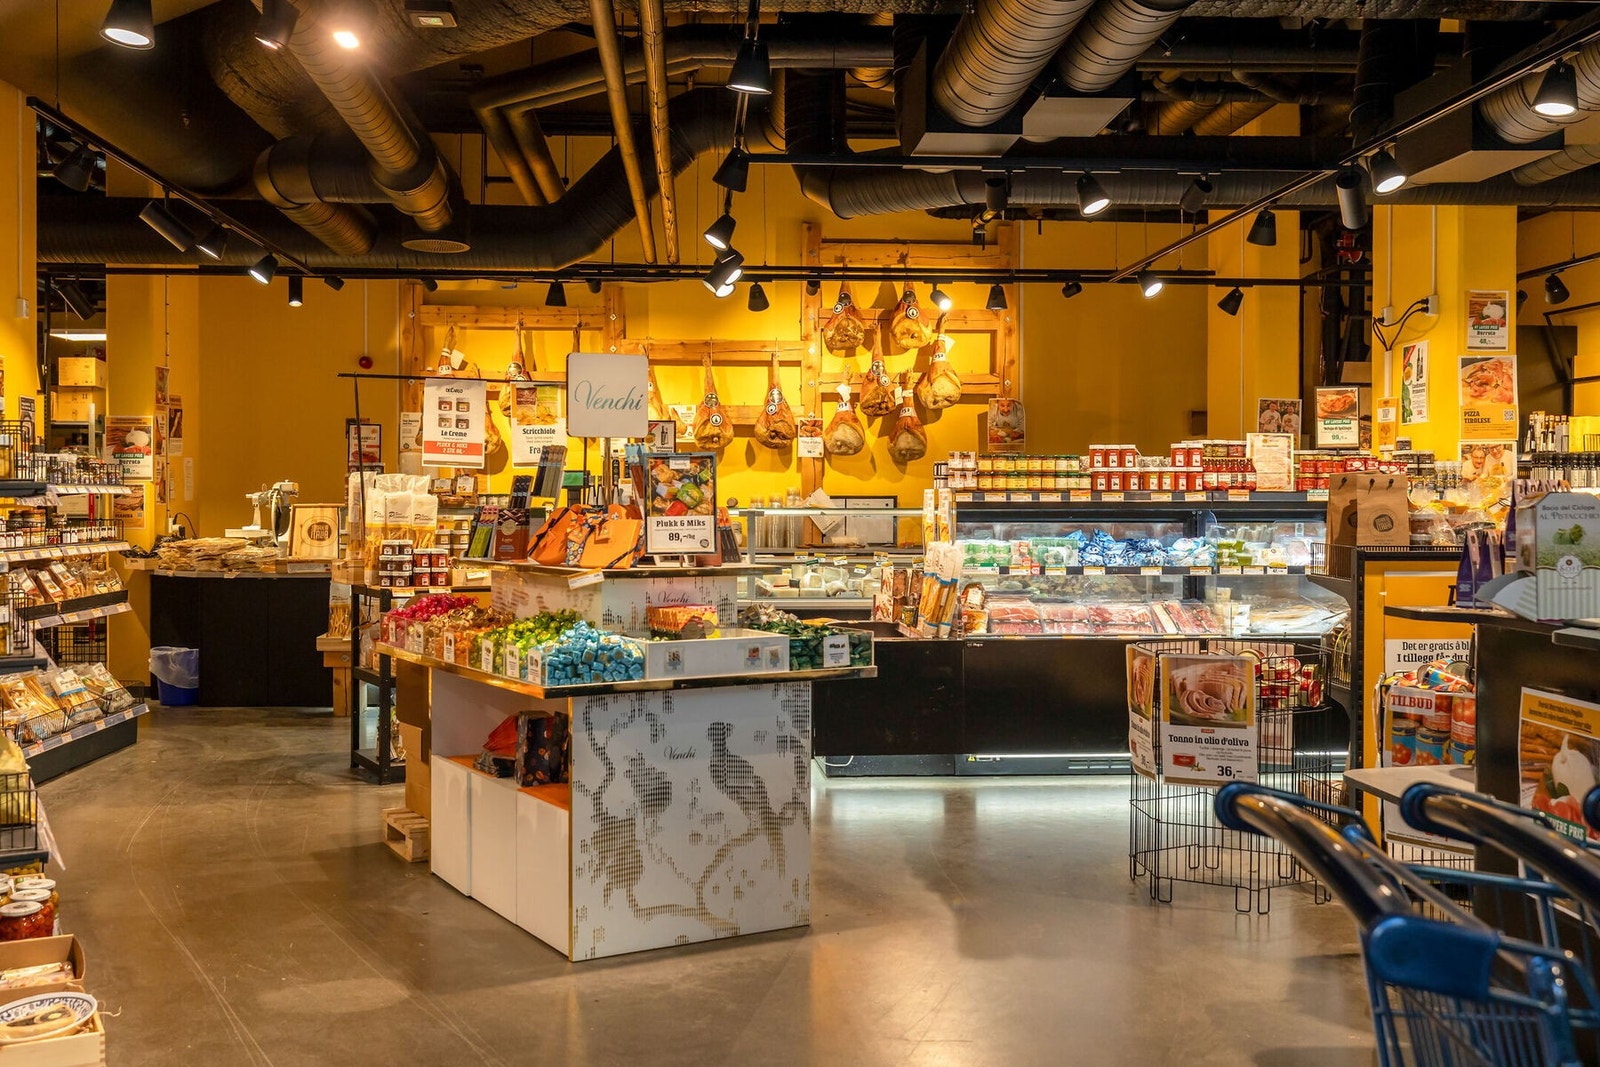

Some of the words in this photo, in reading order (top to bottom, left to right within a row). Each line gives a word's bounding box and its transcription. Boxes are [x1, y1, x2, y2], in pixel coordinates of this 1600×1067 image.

[574, 380, 644, 410] Venchi
[658, 591, 688, 603] Venchi
[1402, 641, 1417, 650] Det
[1429, 641, 1454, 652] gratis
[1455, 641, 1460, 650] å
[1461, 641, 1470, 650] bl
[1397, 654, 1402, 662] I
[1403, 653, 1434, 664] tillegg
[1391, 694, 1433, 710] TILBUD
[1168, 734, 1194, 744] Tonno
[1194, 736, 1203, 744] in
[1204, 736, 1220, 745] olio
[1221, 737, 1249, 746] d'oliva
[663, 745, 696, 760] Venchi
[1217, 765, 1242, 779] 36,-
[1568, 824, 1584, 840] PRIS
